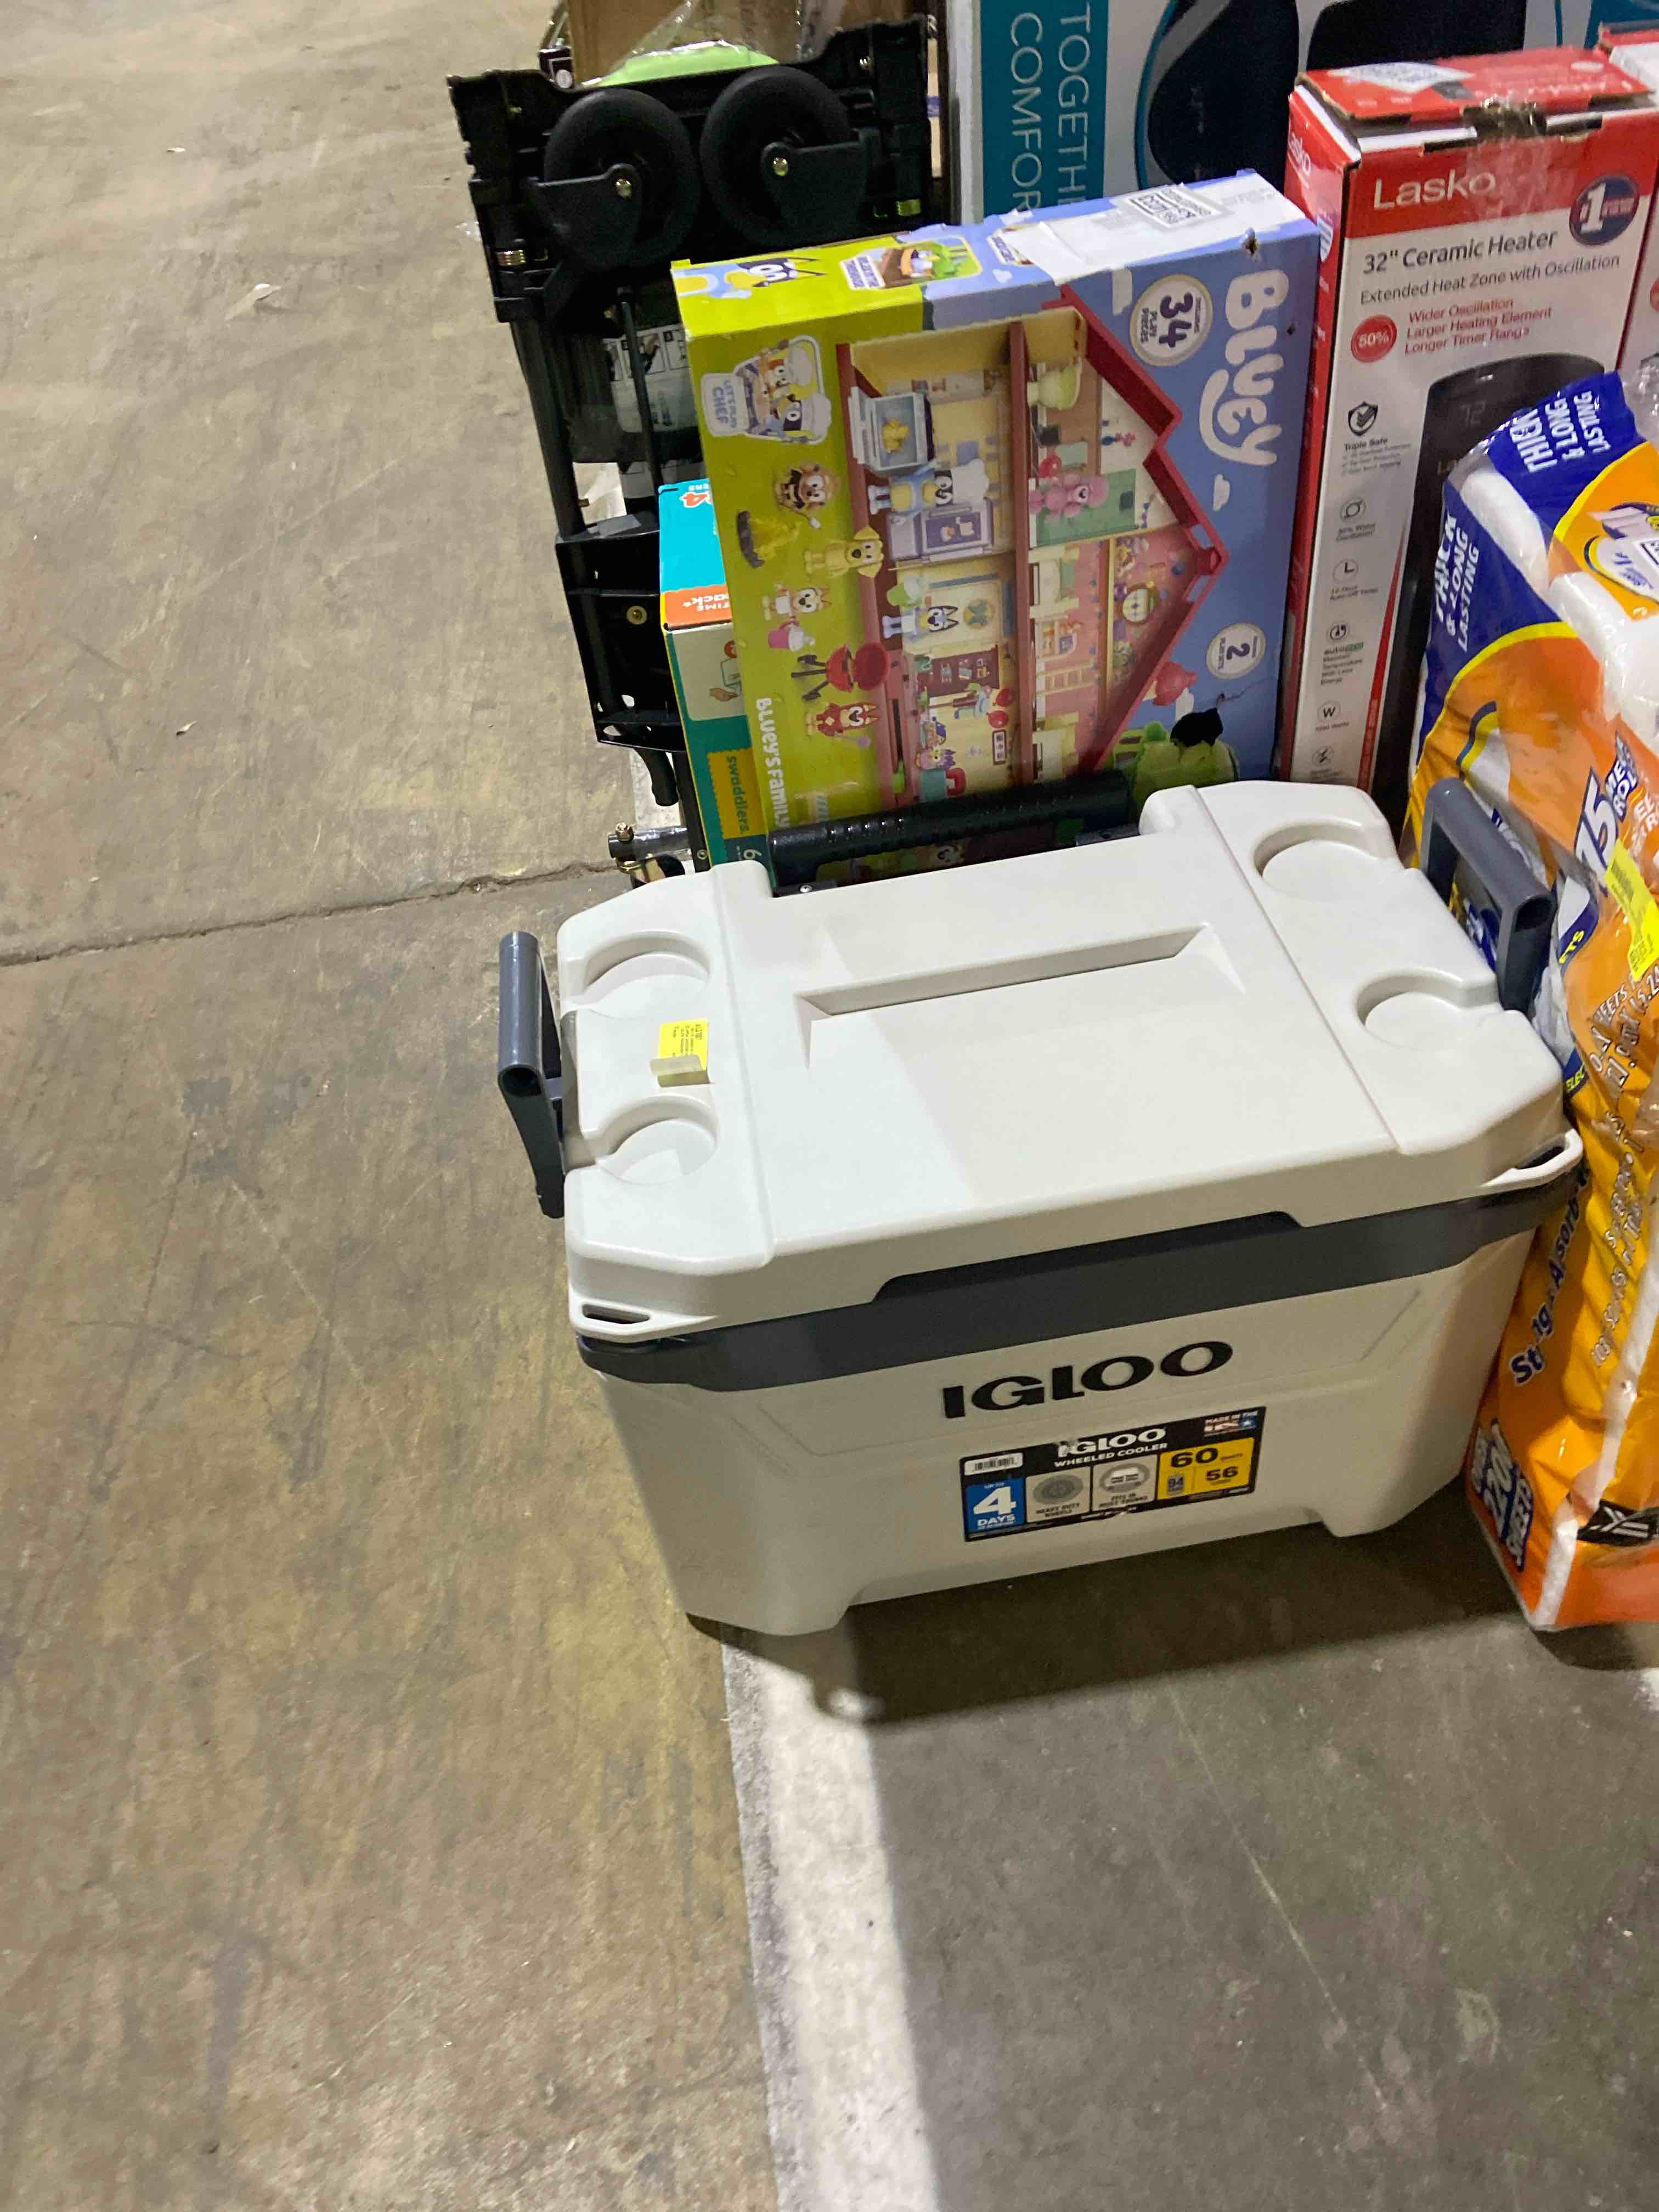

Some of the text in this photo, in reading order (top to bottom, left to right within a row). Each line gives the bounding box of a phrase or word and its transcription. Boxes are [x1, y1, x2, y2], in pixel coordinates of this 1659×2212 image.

[1058, 1, 1092, 205] TOGETH
[1373, 169, 1496, 211] Lasko
[1363, 230, 1559, 274] 32" Ceramic Heater
[1360, 255, 1621, 305] Extended Heat Zone with Oscillation
[1159, 292, 1193, 348] 34
[1406, 307, 1553, 340] Larger Heating Element
[1408, 297, 1514, 324] Wider Oscillation
[1357, 331, 1390, 346] 50%
[1404, 338, 1448, 356] Longer
[1452, 332, 1486, 348] Timer
[1509, 408, 1559, 473] THICK
[1544, 398, 1578, 450] LONG
[1573, 390, 1611, 454] LASTING
[1434, 510, 1457, 624] THICK
[1449, 526, 1468, 613] LONG
[1458, 543, 1480, 653] LASTING
[1227, 643, 1250, 661] 2
[726, 755, 750, 832] swaddlers
[942, 1340, 1234, 1419] IGLOO
[1054, 1442, 1169, 1469] WHEELED COOLER
[1056, 1427, 1167, 1458] IGLOO
[1171, 1447, 1219, 1469] 60
[1205, 1465, 1239, 1482] 56
[973, 1486, 1017, 1516] 4
[977, 1514, 1015, 1527] DAYS
